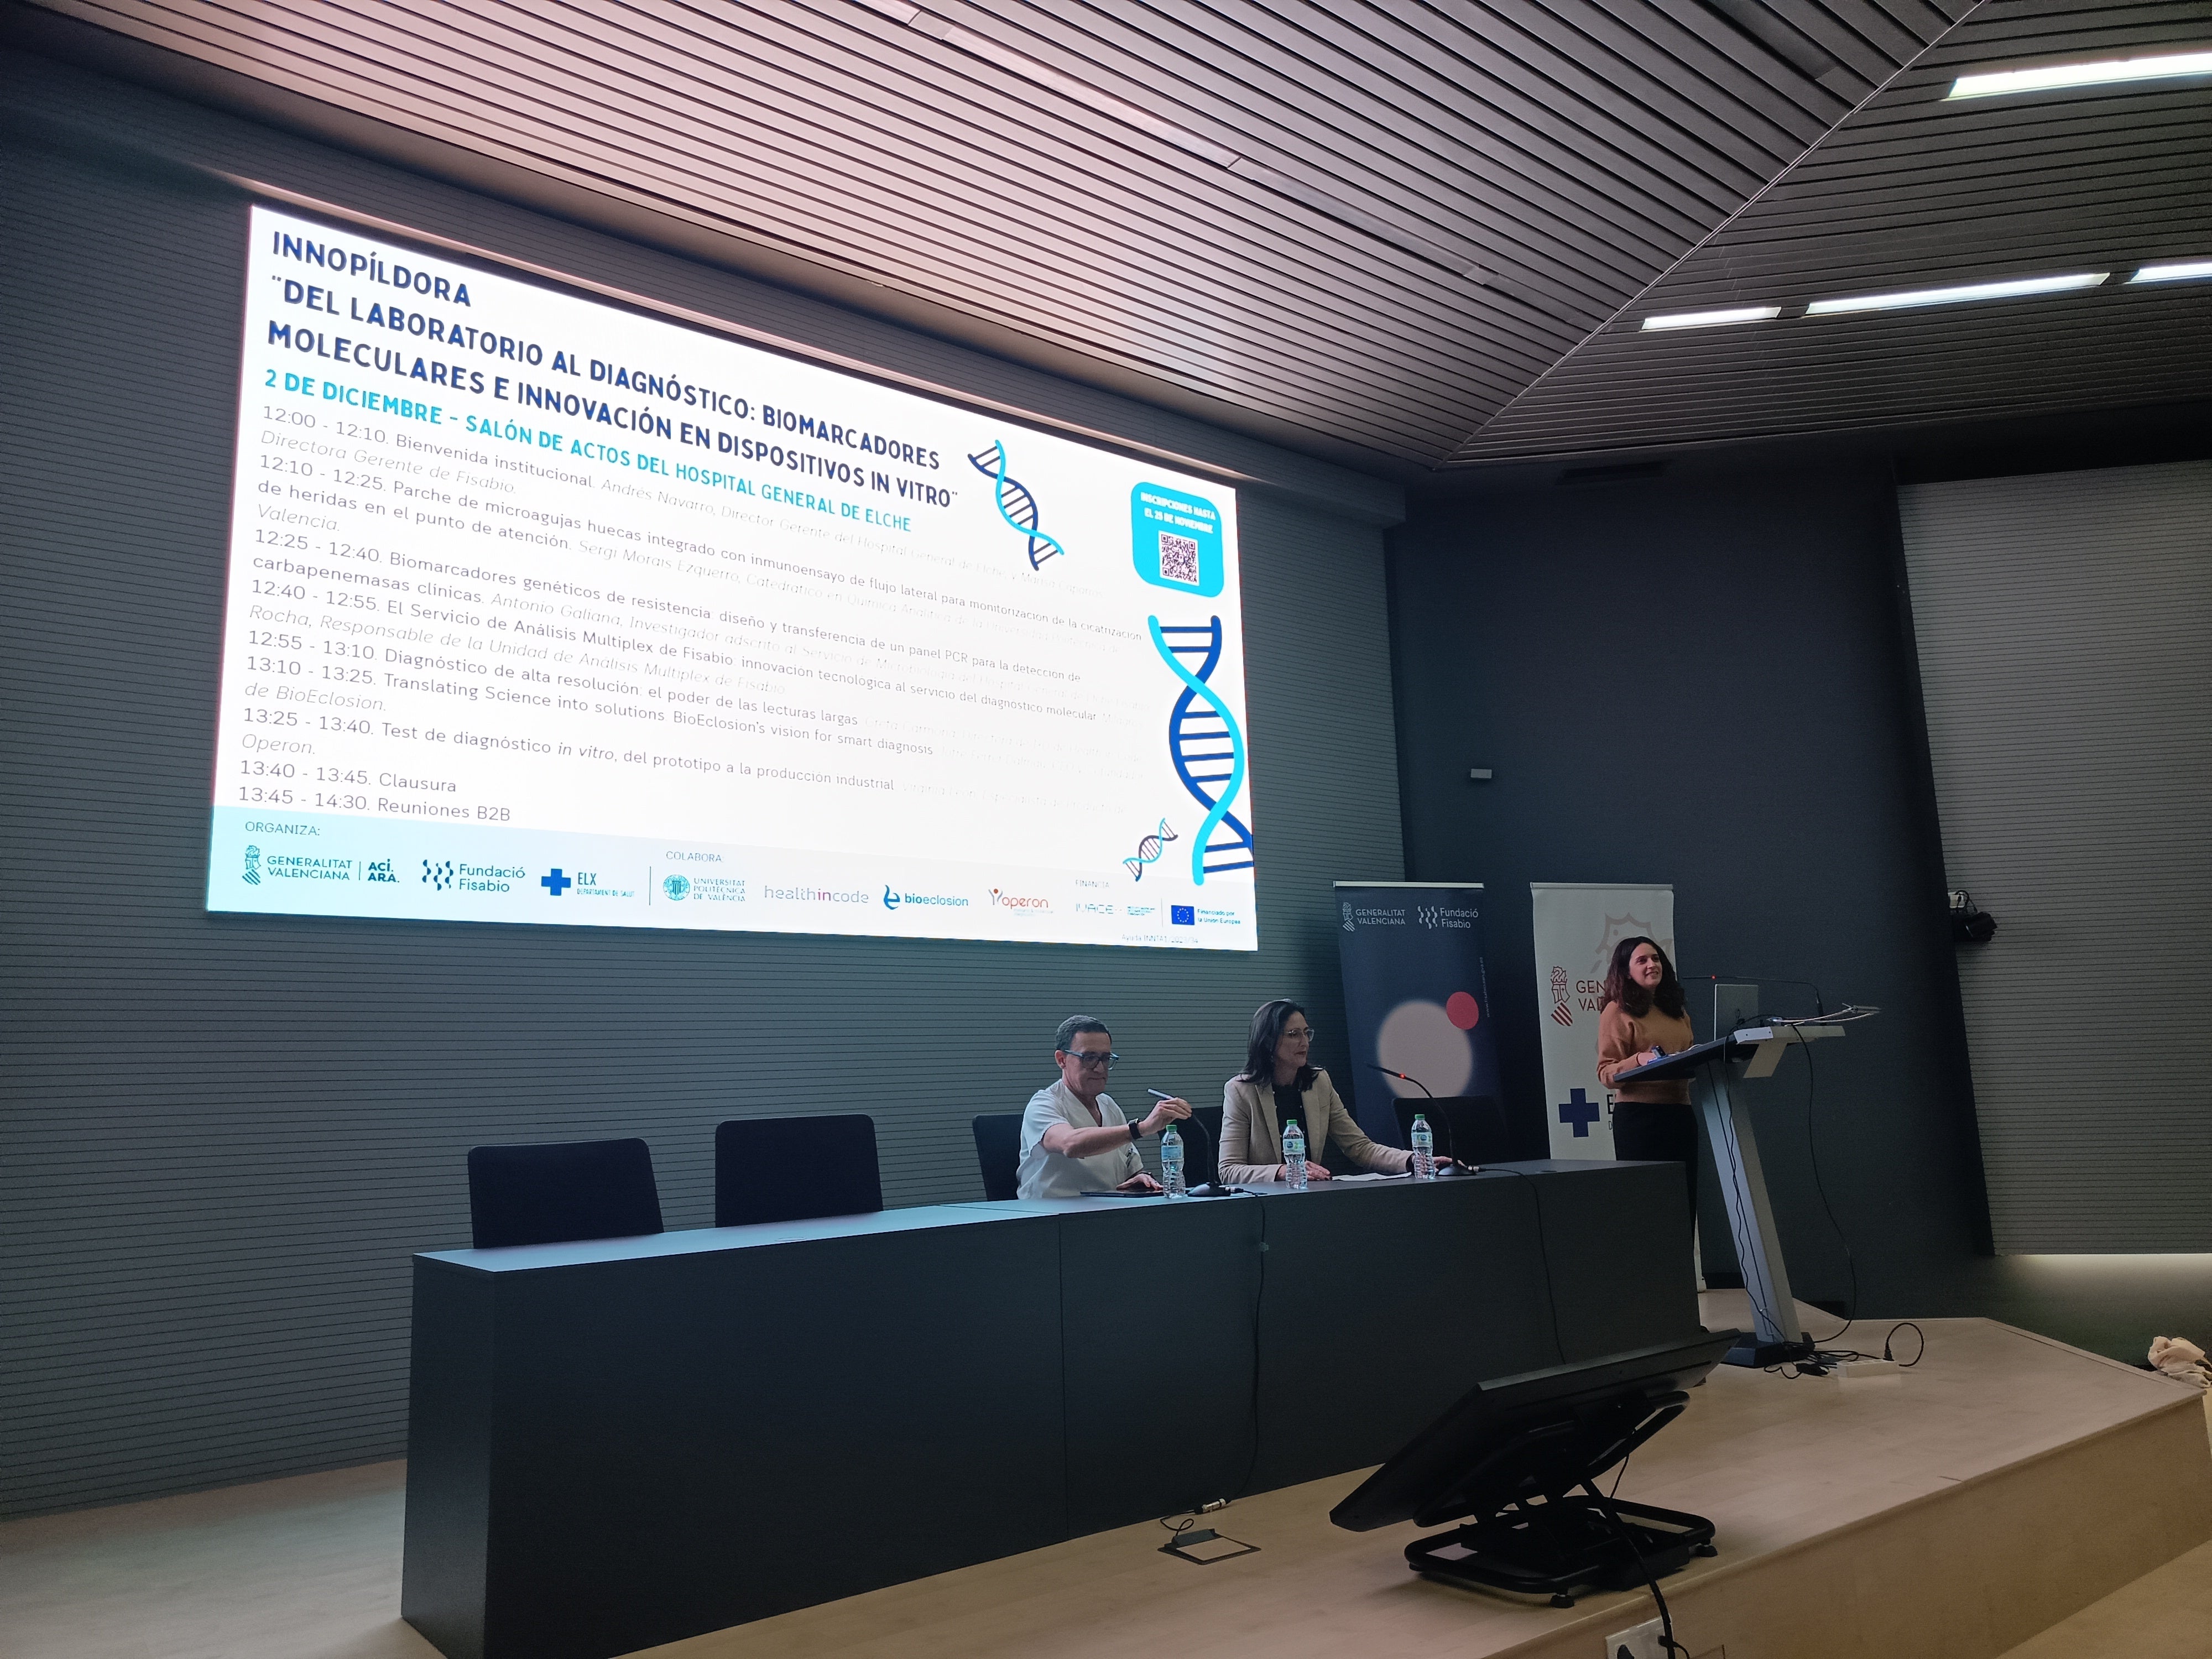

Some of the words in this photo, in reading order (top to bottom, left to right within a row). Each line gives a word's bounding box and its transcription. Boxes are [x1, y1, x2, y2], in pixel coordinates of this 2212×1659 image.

[273, 231, 471, 307] INNOPÍLDORA
[351, 296, 542, 366] LABORATORIO
[551, 350, 580, 377] AL
[590, 359, 754, 420] DIAGNÓSTICO:
[763, 404, 939, 469] BIOMARCADORES
[268, 320, 484, 394] MOLECULARES
[493, 375, 509, 400] E
[518, 382, 671, 440] INNOVACIÓN
[680, 421, 710, 449] EN
[718, 431, 864, 487] DISPOSITIVOS
[871, 471, 889, 493] IN
[263, 405, 316, 428] 12:00
[336, 421, 388, 444] 12:10.
[396, 433, 488, 465] Bienvenida
[264, 368, 276, 388] 2
[284, 372, 315, 396] DE
[322, 381, 442, 425] DICIEMBRE
[465, 414, 532, 445] SALÓN
[538, 430, 562, 451] DE
[570, 439, 630, 466] ACTOS
[637, 453, 669, 476] DEL
[676, 463, 755, 495] HOSPITAL
[761, 483, 834, 514] GENERAL
[841, 502, 859, 520] DE
[865, 508, 910, 531] ELCHE
[260, 430, 346, 459] Directora
[353, 449, 422, 474] Gerente
[429, 466, 450, 480] de
[456, 470, 515, 494] Fisabio.
[257, 479, 281, 495] de
[289, 484, 357, 509] heridas
[364, 503, 385, 515] en
[393, 506, 409, 520] el
[415, 512, 465, 529] punto
[471, 520, 492, 535] de
[498, 527, 571, 550] atención.
[258, 503, 340, 531] Valencia.
[260, 454, 313, 476] 12:10
[333, 468, 385, 492] 12:25.
[393, 480, 451, 504] Parche
[458, 494, 478, 509] de
[485, 501, 581, 529] microagujas
[587, 519, 641, 541] huecas
[647, 531, 714, 556] integrado
[721, 550, 745, 562] con
[751, 552, 844, 583] inmunoensayo
[253, 557, 409, 591] carbapenemasas
[417, 581, 484, 603] clínicas.
[255, 529, 308, 550] 12:25
[329, 541, 382, 563] 12:40.
[390, 551, 516, 585] Biomarcadores
[523, 578, 600, 599] genéticos
[606, 590, 625, 604] de
[249, 604, 311, 628] Rocha,
[320, 615, 434, 643] Responsable
[440, 633, 461, 647] de
[467, 635, 483, 650] la
[252, 579, 305, 600] 12:40
[326, 591, 379, 611] 12:55.
[388, 599, 403, 615] El
[410, 603, 479, 626] Servicio
[487, 615, 507, 630] de
[513, 619, 576, 641] Análisis
[582, 630, 653, 653] Multiplex
[659, 643, 677, 656] de
[248, 630, 302, 650] 12:55
[324, 640, 377, 660] 13:10.
[385, 648, 487, 674] Diagnóstico
[494, 664, 514, 678] de
[521, 668, 550, 683] alta
[648, 686, 661, 698] el
[667, 691, 710, 705] poder
[715, 695, 733, 708] de
[738, 697, 757, 711] las
[763, 701, 816, 719] lecturas
[821, 709, 858, 726] largas
[244, 682, 269, 697] de
[276, 685, 385, 711] BioEclosion.
[247, 655, 301, 675] 13:10
[322, 665, 375, 685] 13:25.
[383, 672, 478, 701] Translating
[484, 686, 551, 706] Science
[557, 695, 588, 711] into
[674, 710, 765, 734] BioEclosion's
[770, 724, 809, 739] vision
[815, 728, 832, 741] for
[837, 735, 872, 747] smart
[877, 738, 932, 755] diagnosis
[242, 733, 315, 754] Operon.
[244, 707, 298, 726] 13:25
[319, 716, 373, 734] 13:40.
[381, 722, 418, 739] Test
[424, 727, 446, 742] de
[453, 731, 551, 753] diagnóstico
[557, 742, 572, 755] in
[579, 745, 617, 763] vitro,
[623, 749, 647, 764] del
[653, 755, 721, 773] prototipo
[726, 764, 733, 773] a
[740, 762, 751, 775] la
[757, 767, 831, 783] producción
[836, 773, 894, 790] industrial
[240, 759, 295, 778] 13:40
[316, 766, 371, 785] 13:45.
[379, 772, 456, 792] Clausura
[239, 786, 293, 804] 13:45
[315, 792, 370, 810] 14:30.
[378, 797, 469, 818] Reuniones
[477, 805, 510, 821] B2B
[245, 821, 320, 836] ORGANIZA:
[267, 855, 352, 869] GENERALITAT
[268, 868, 350, 880] VALENCIANA
[459, 864, 525, 879] Fundació
[578, 872, 597, 885] ELX
[459, 879, 510, 892] Fisabio
[693, 878, 745, 886] UNIVERSITAT
[764, 885, 869, 903] healthincode
[905, 893, 968, 906] bioeclosion
[1439, 907, 1479, 918] Fundació
[1441, 919, 1471, 928] Fisabio
